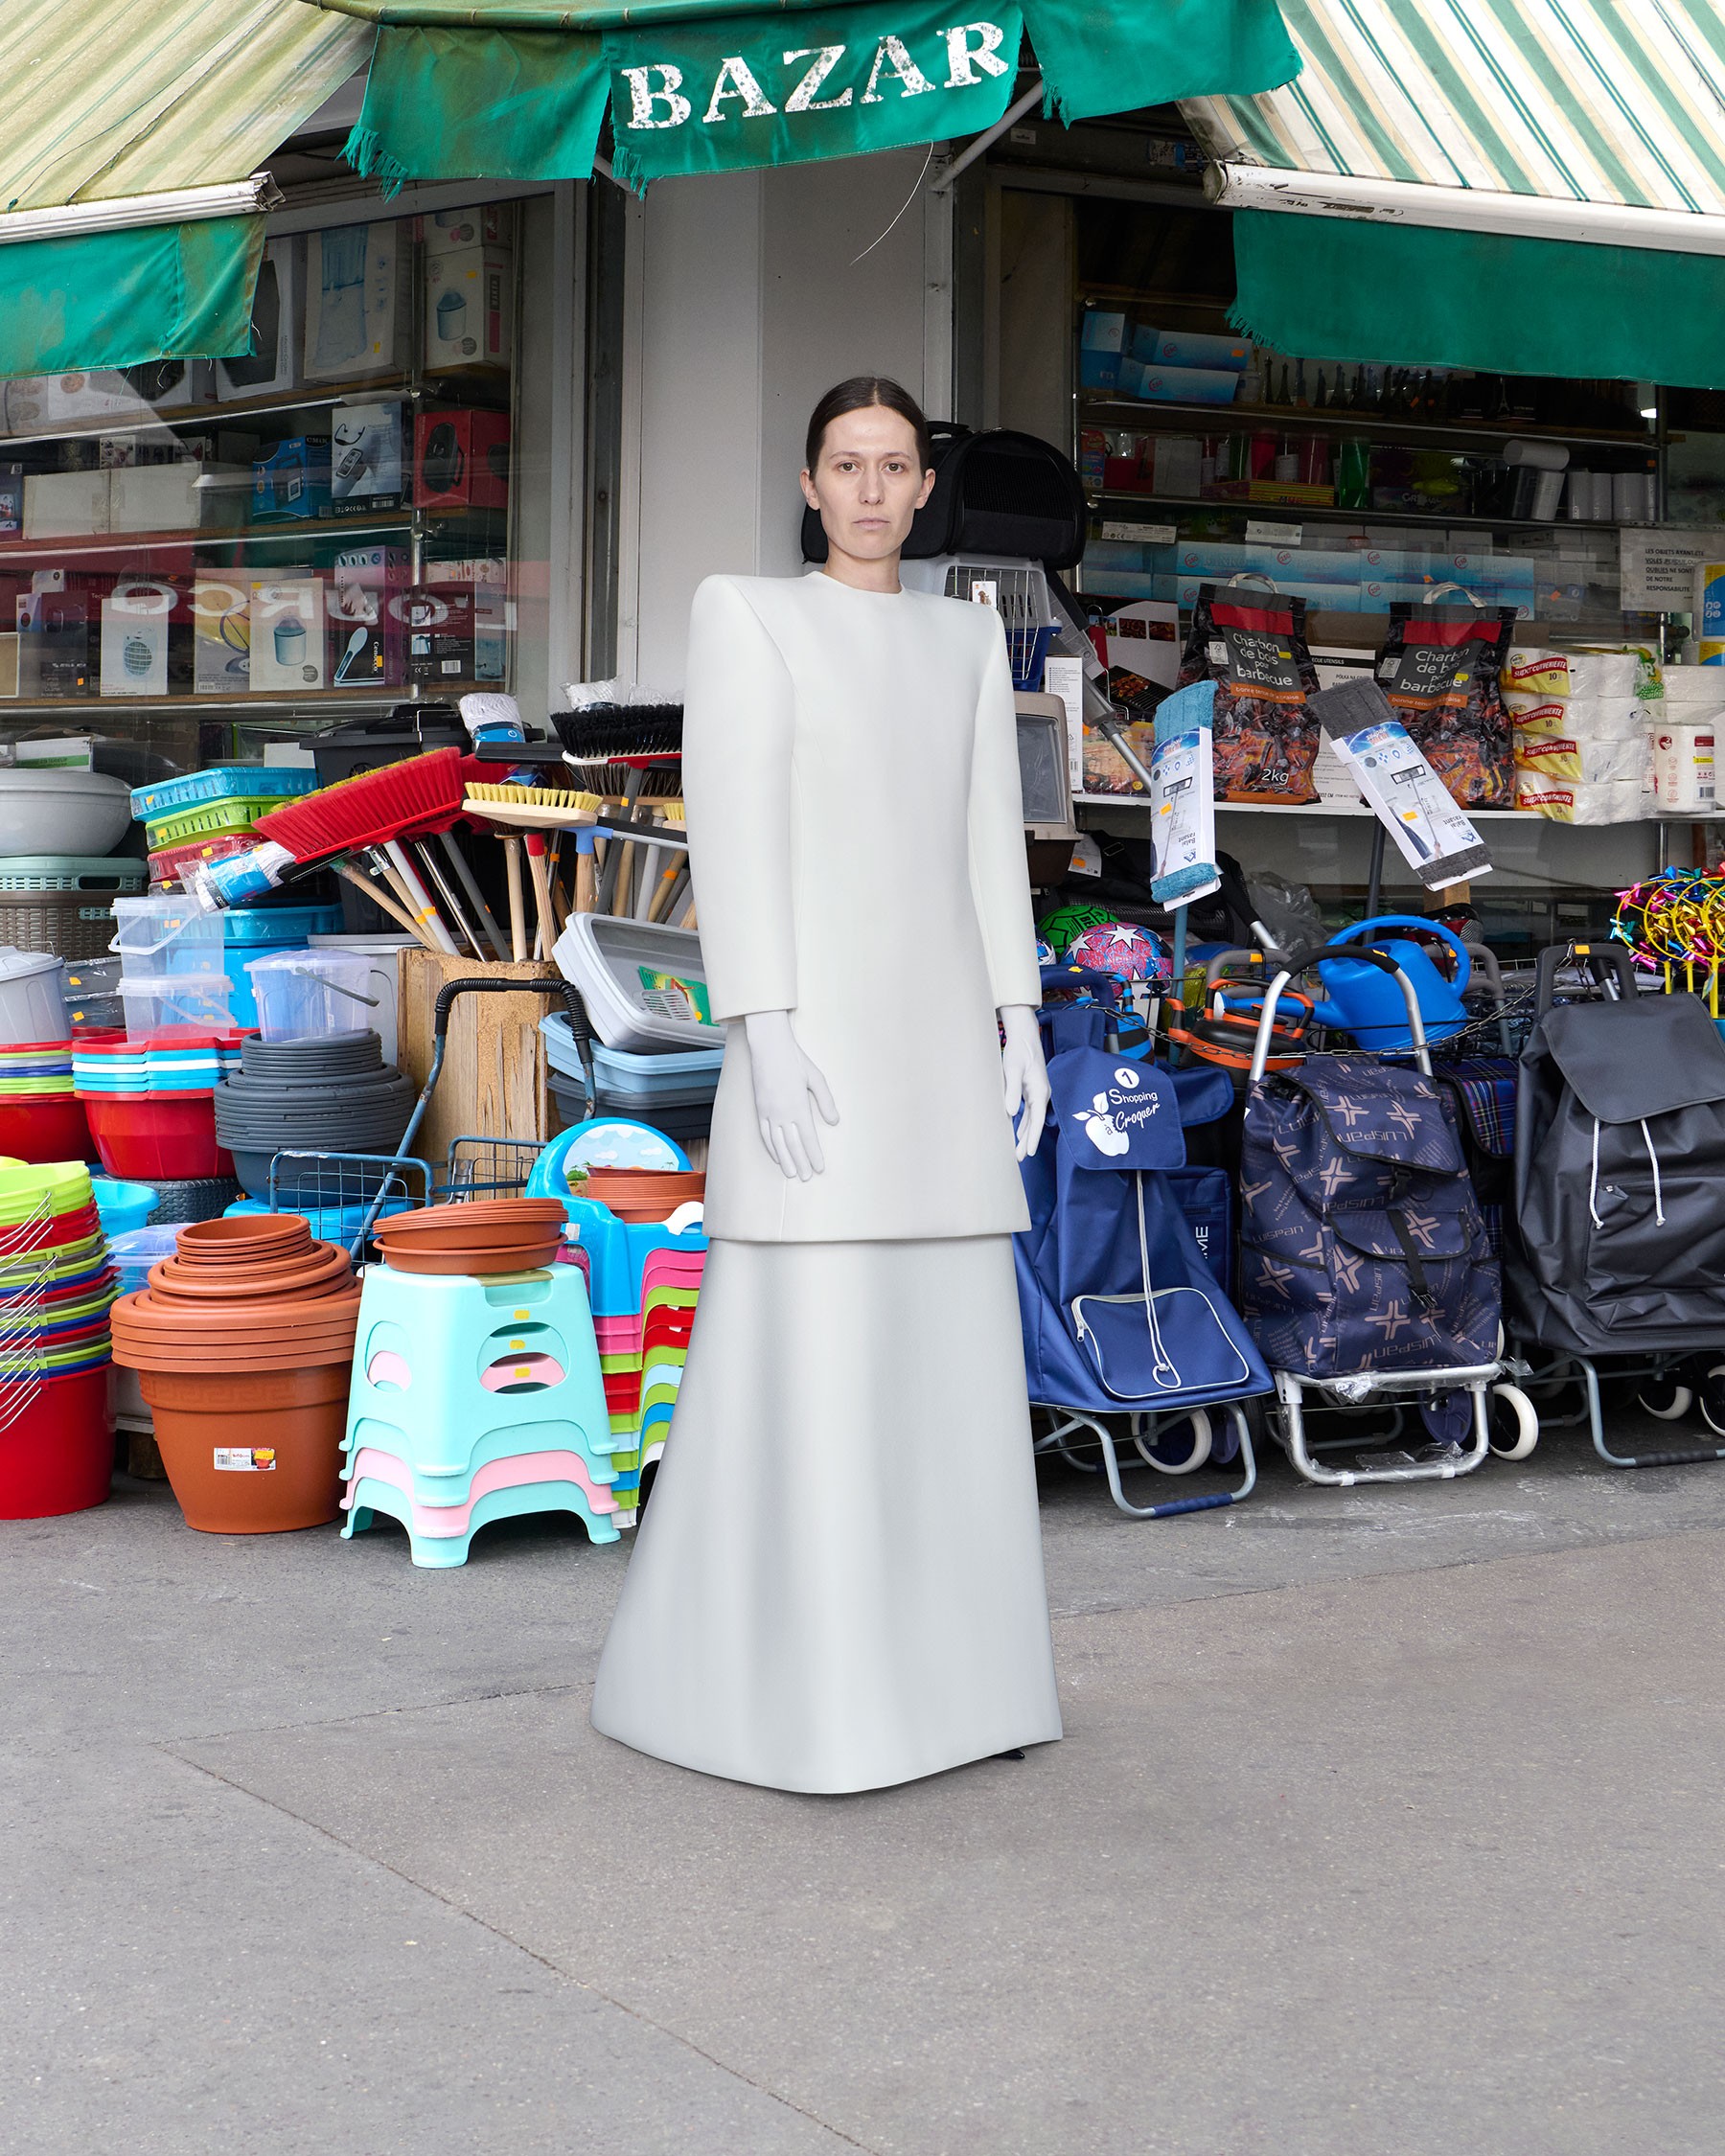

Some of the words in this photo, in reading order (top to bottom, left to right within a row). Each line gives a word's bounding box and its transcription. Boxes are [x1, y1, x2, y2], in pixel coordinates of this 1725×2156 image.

[620, 21, 1009, 130] BAZAR
[1232, 632, 1280, 654] Charbon
[1236, 664, 1293, 686] barbecue
[1416, 662, 1437, 675] de
[1549, 672, 1557, 680] 10
[1545, 720, 1553, 728] 10
[1261, 768, 1290, 786] 2kg
[1442, 814, 1462, 827] rasant
[1177, 831, 1196, 843] rasant
[1181, 837, 1196, 847] Balai
[1121, 1070, 1134, 1086] 1
[1108, 1088, 1159, 1105] Shopping
[1116, 1102, 1162, 1131] Croquer
